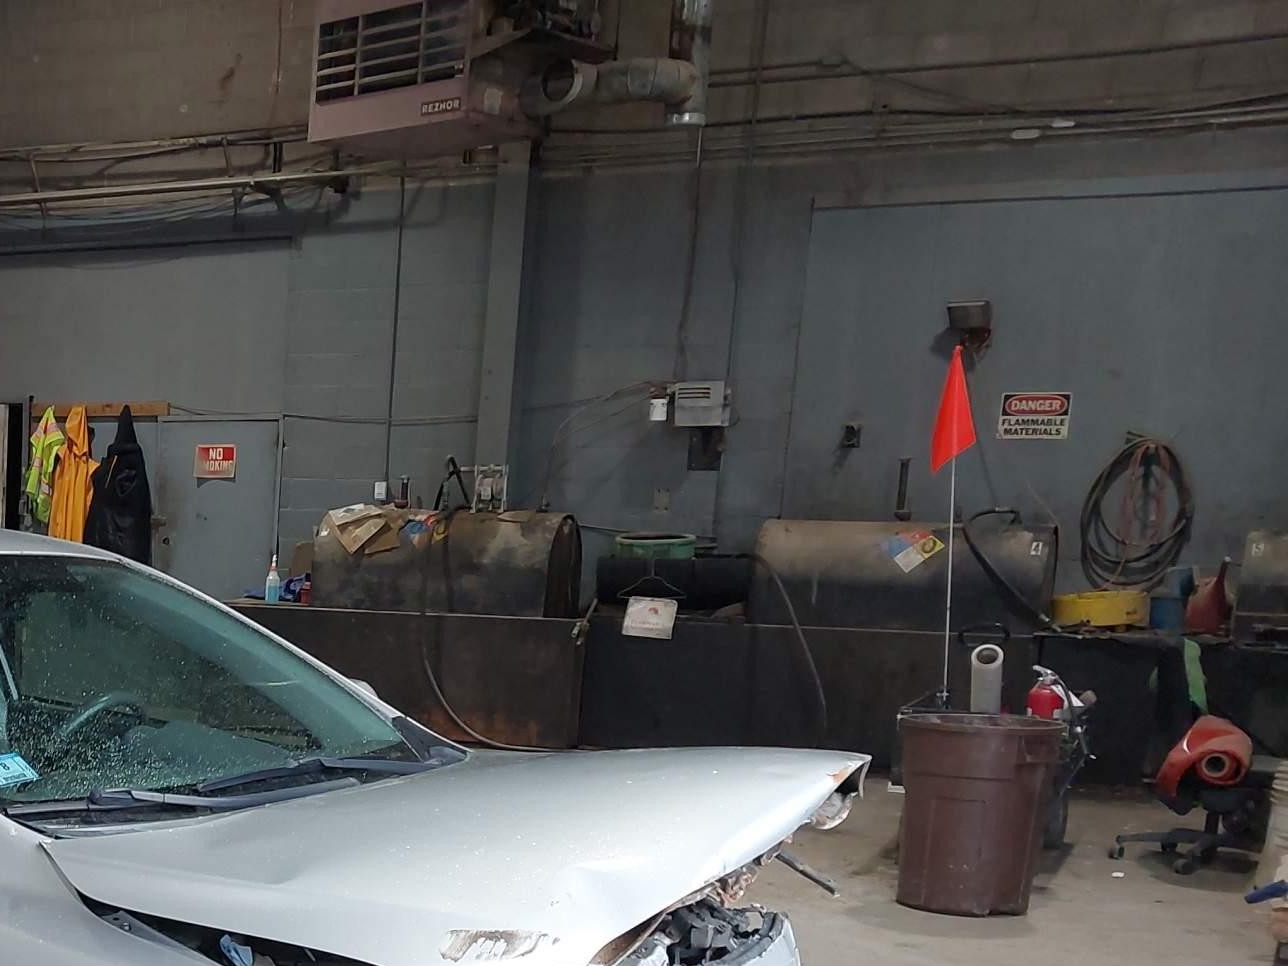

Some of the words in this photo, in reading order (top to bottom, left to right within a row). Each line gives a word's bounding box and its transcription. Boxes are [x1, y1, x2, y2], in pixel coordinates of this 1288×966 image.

[422, 100, 460, 113] REZNOR
[1010, 400, 1062, 411] DANGER
[1001, 418, 1067, 427] FLAMMABLE
[1003, 428, 1062, 436] MATERIALS
[209, 448, 223, 460] NO
